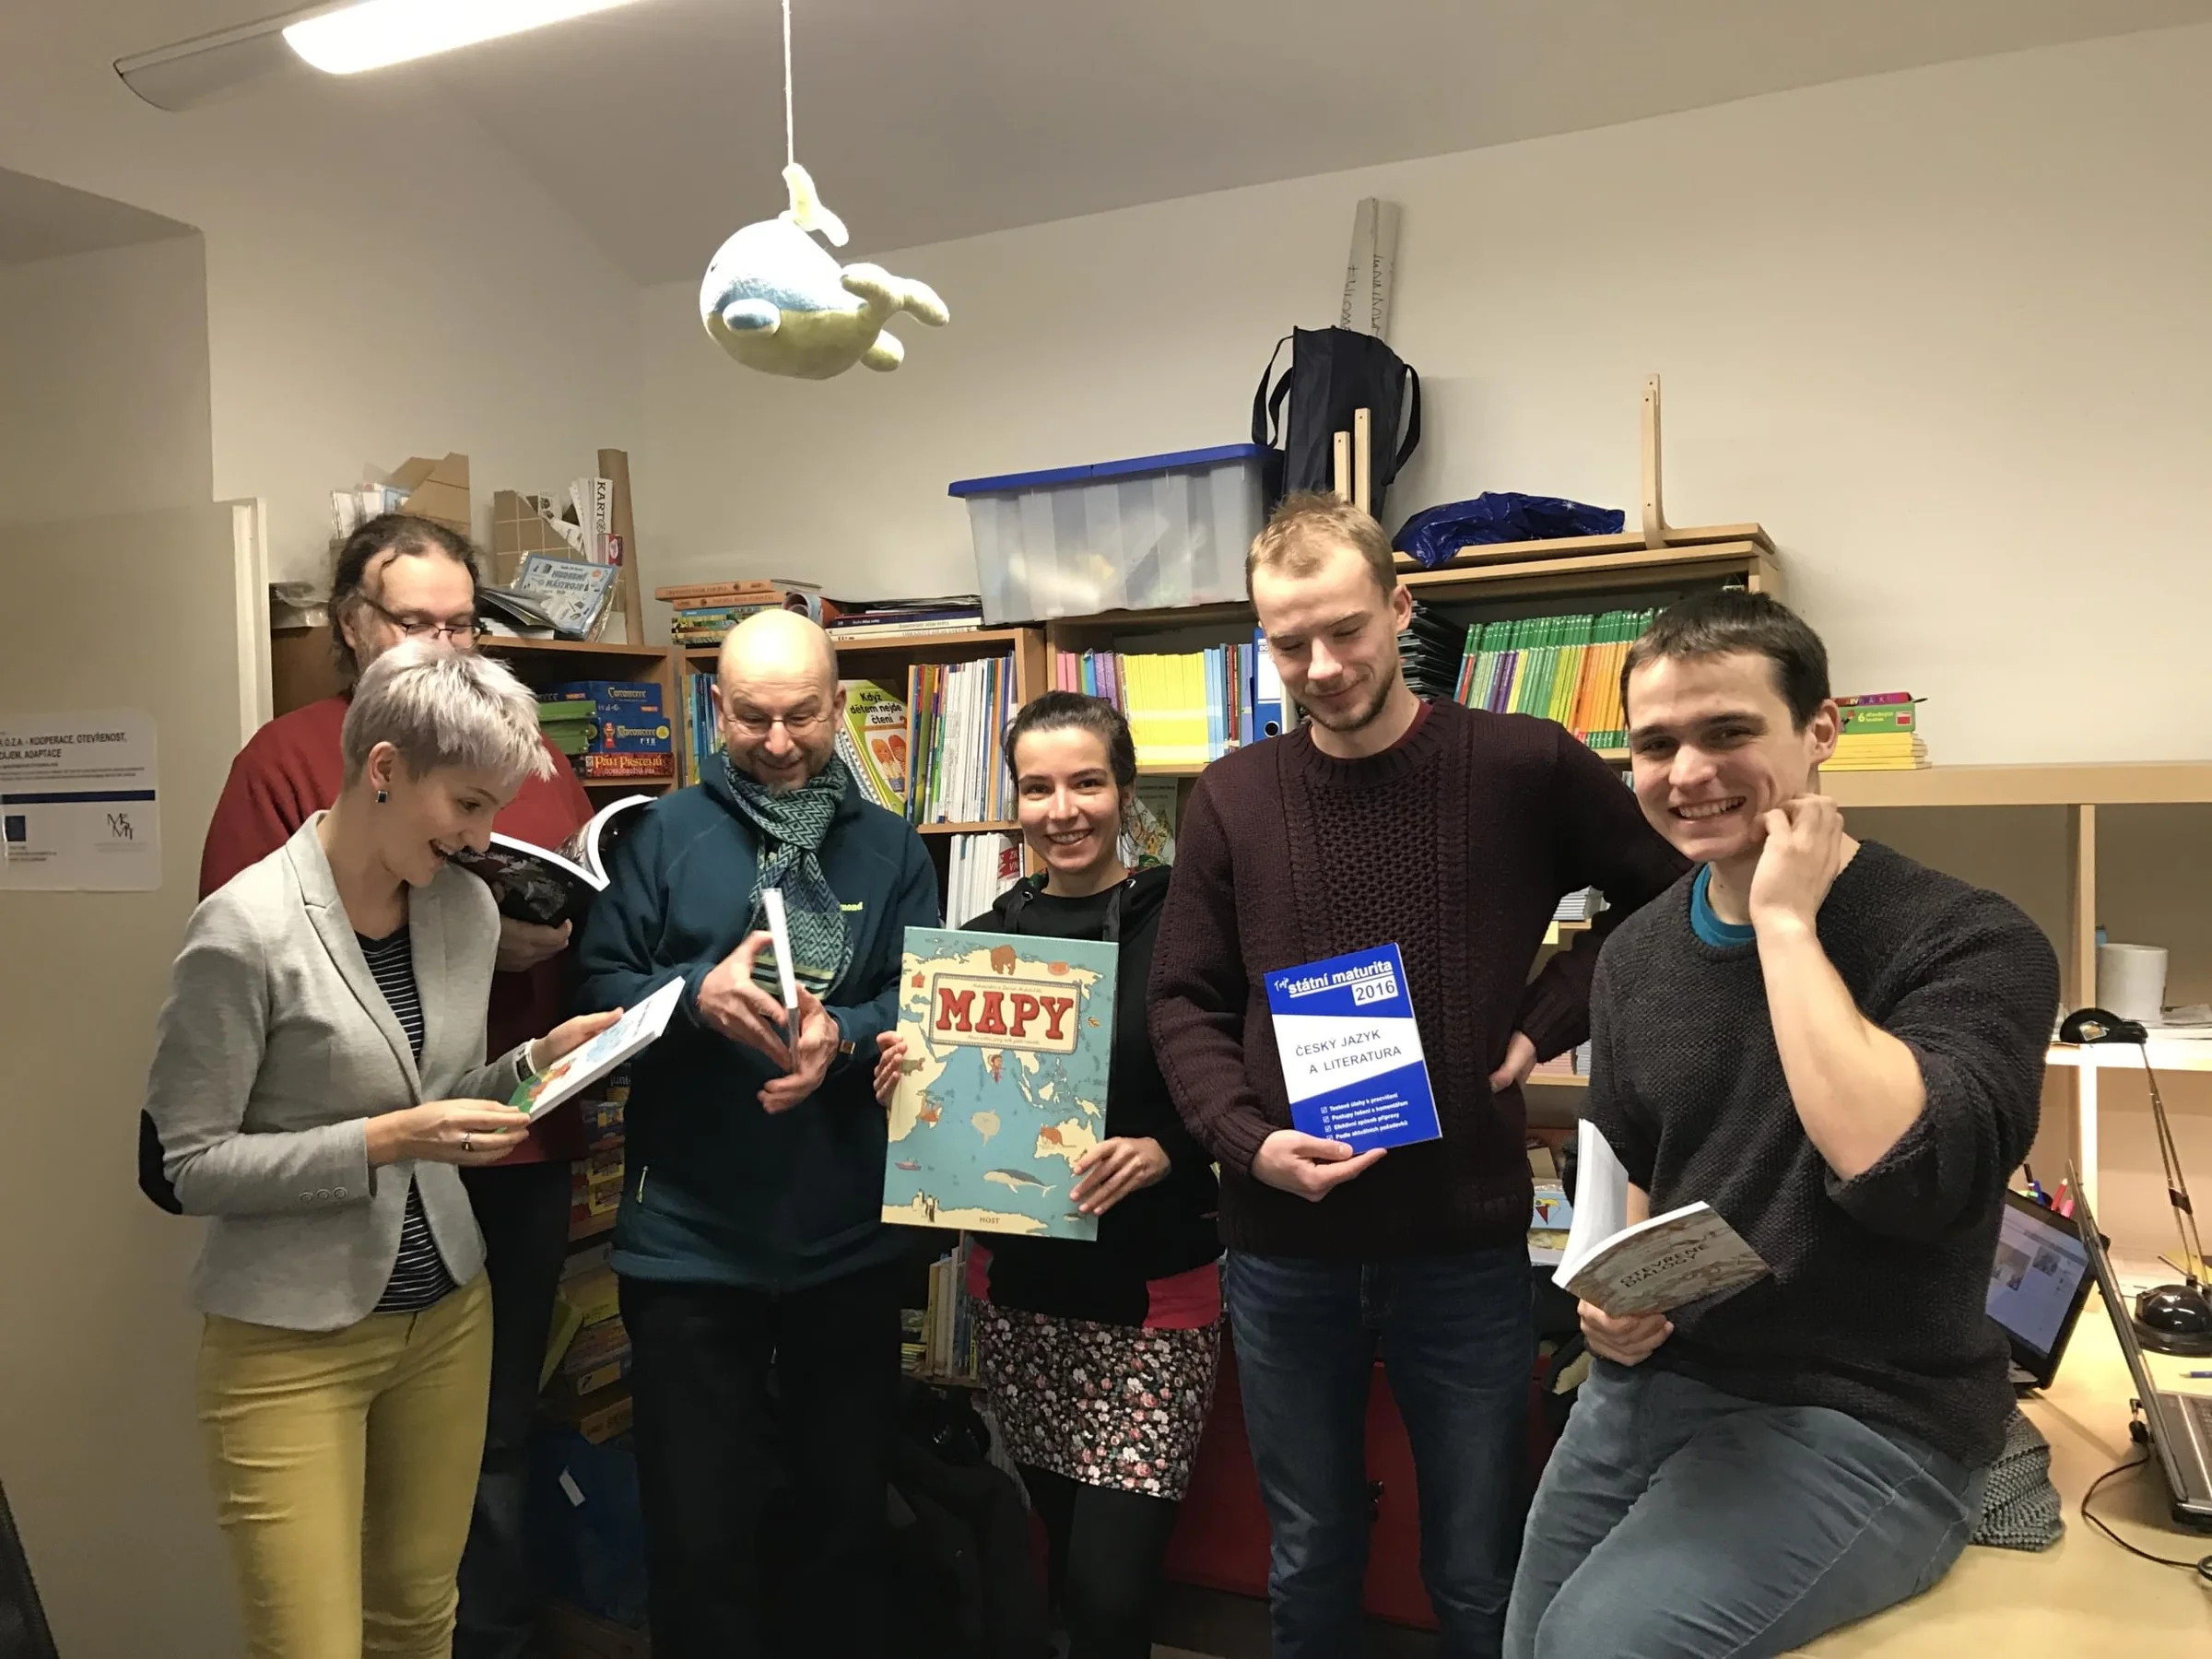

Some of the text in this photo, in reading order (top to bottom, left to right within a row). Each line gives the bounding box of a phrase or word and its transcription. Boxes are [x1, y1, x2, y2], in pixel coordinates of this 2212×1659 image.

[859, 692, 883, 703] Když
[850, 702, 902, 714] dětem nejde
[1857, 712, 1865, 723] 6
[1288, 973, 1329, 994] státní
[1332, 960, 1393, 984] maturita
[1355, 980, 1395, 1002] 2016
[935, 987, 1074, 1040] MAPY
[1341, 1030, 1382, 1048] JAZYK
[1309, 1046, 1402, 1075] A LITERATURA
[979, 1217, 1000, 1225] HOST
